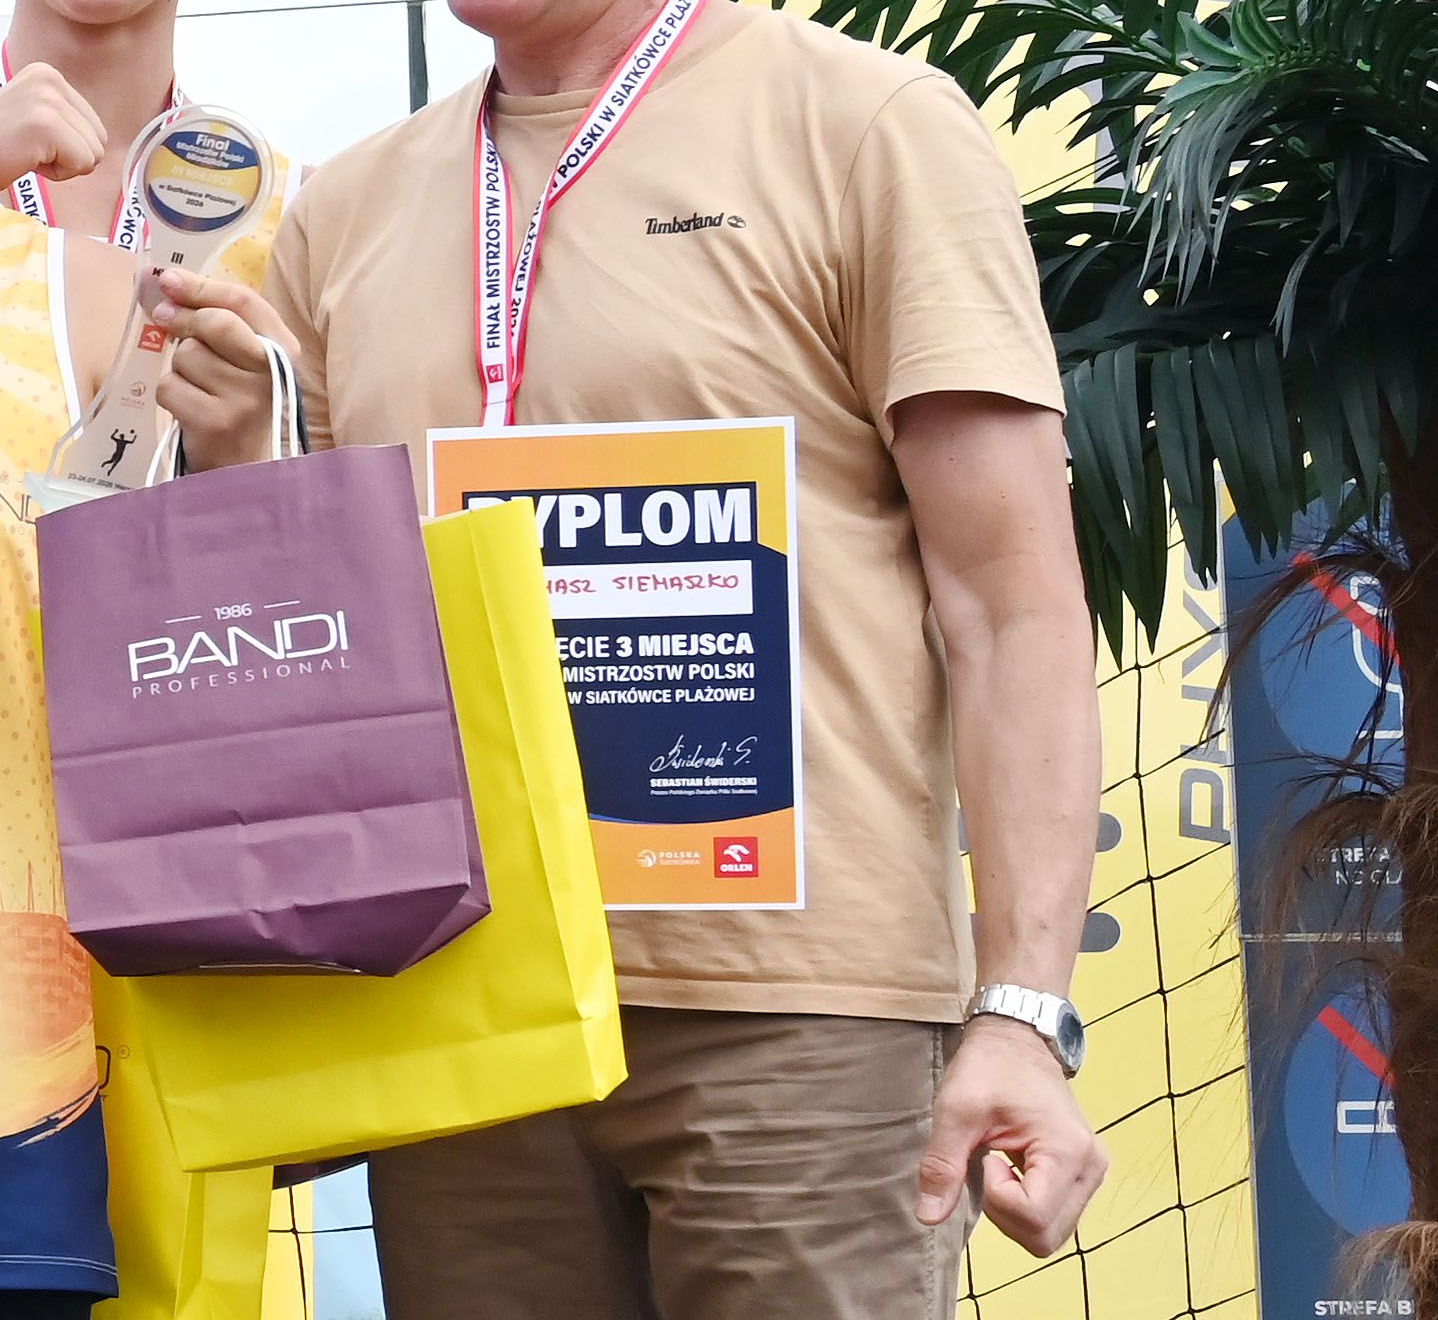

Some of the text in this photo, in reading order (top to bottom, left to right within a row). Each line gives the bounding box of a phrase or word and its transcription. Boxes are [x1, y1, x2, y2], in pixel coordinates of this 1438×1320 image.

[556, 25, 673, 179] POLSKI SIATKÓWCE
[195, 133, 230, 152] Final
[644, 213, 724, 236] Timberland
[485, 195, 502, 350] FINAŁ MISTRZOSTW
[612, 572, 738, 593] SIEMASZKO
[213, 602, 254, 622] 1986
[127, 610, 349, 684] BANDI
[615, 632, 754, 657] 3 MIEJSCA
[131, 656, 350, 700] PROFESSIONAL
[563, 662, 754, 682] MISTRZOSTW POLSKI
[569, 684, 755, 704] W SIATKÓWCE PLAŻOWEJ
[1314, 1299, 1393, 1316] STREFA
